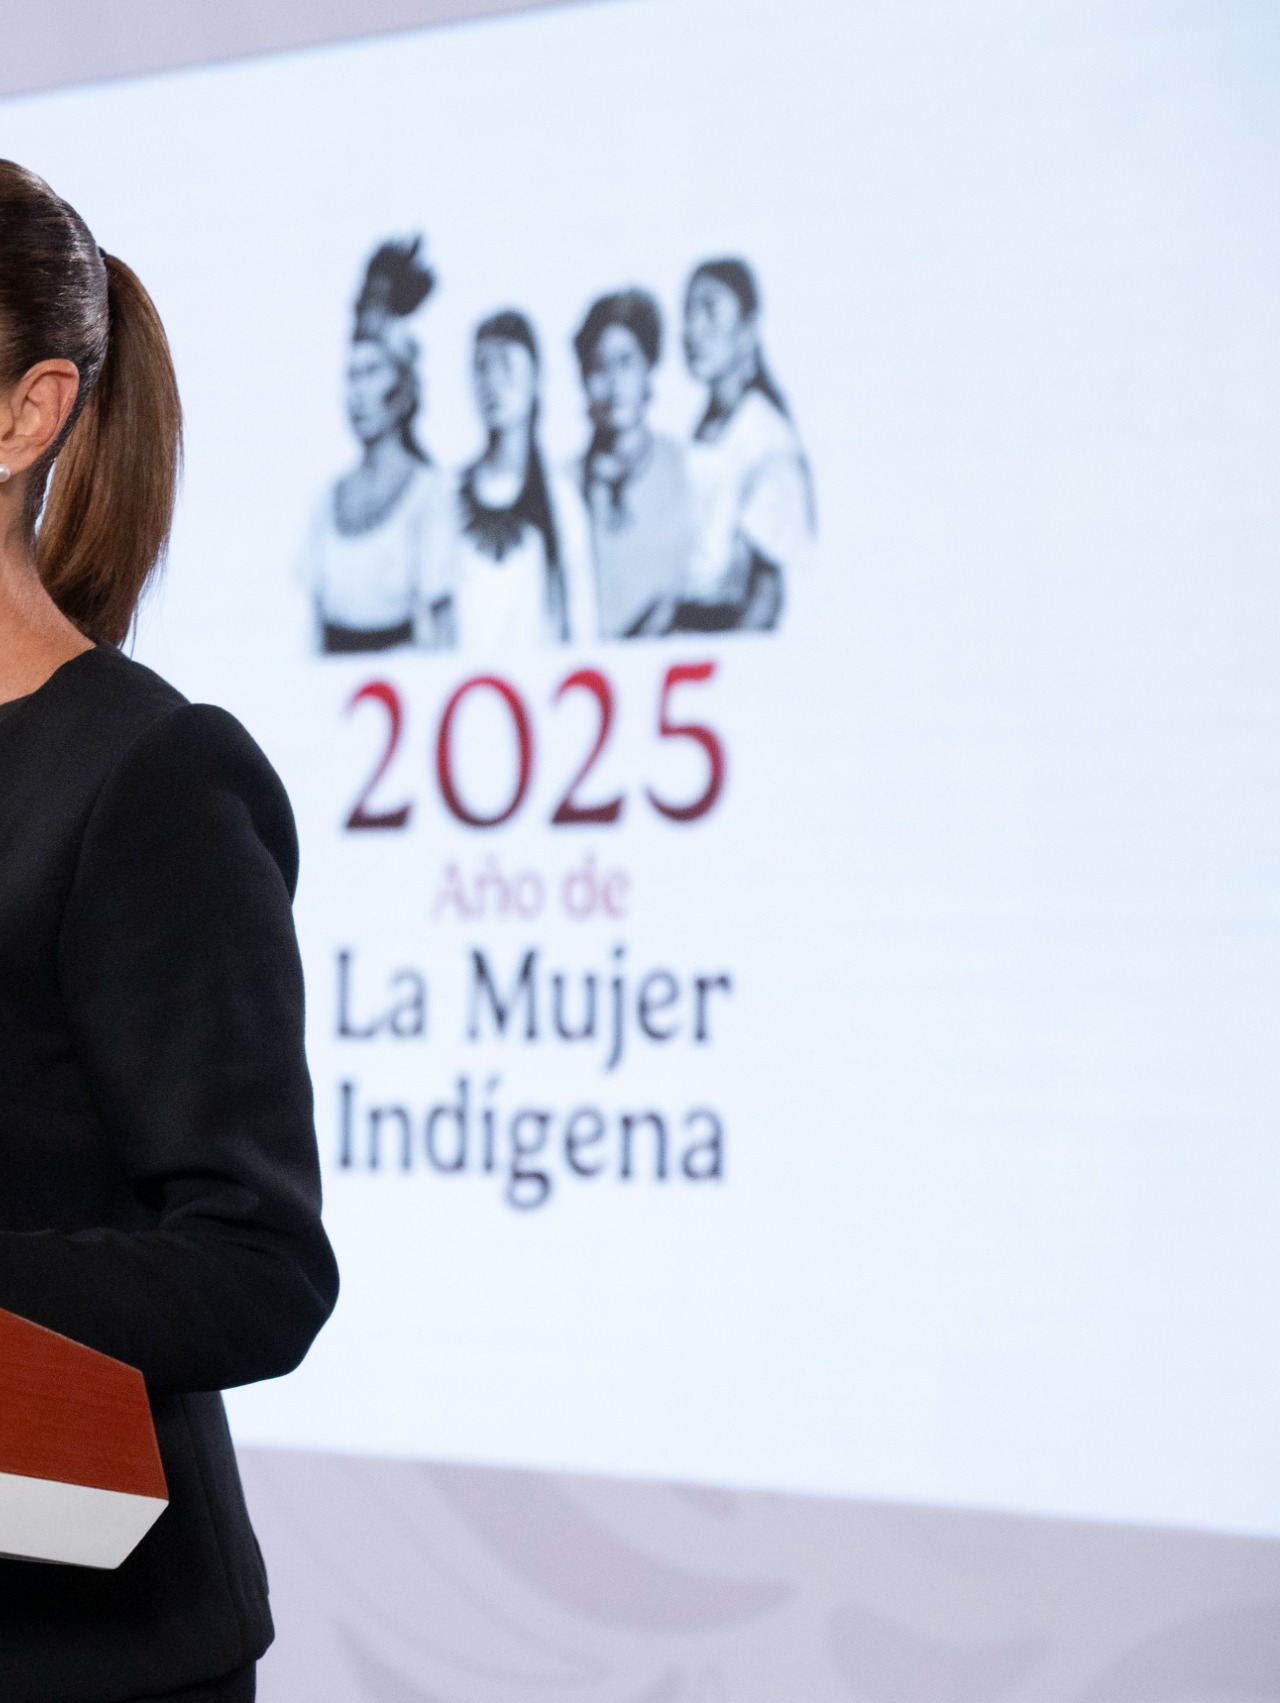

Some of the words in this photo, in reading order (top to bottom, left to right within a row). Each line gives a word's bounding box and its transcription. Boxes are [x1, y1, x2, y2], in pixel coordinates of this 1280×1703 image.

[344, 659, 728, 834] 2025
[438, 853, 547, 920] Año
[561, 852, 631, 919] de
[336, 947, 428, 1041] La
[464, 944, 733, 1072] Mujer
[337, 1075, 726, 1211] Indígena
